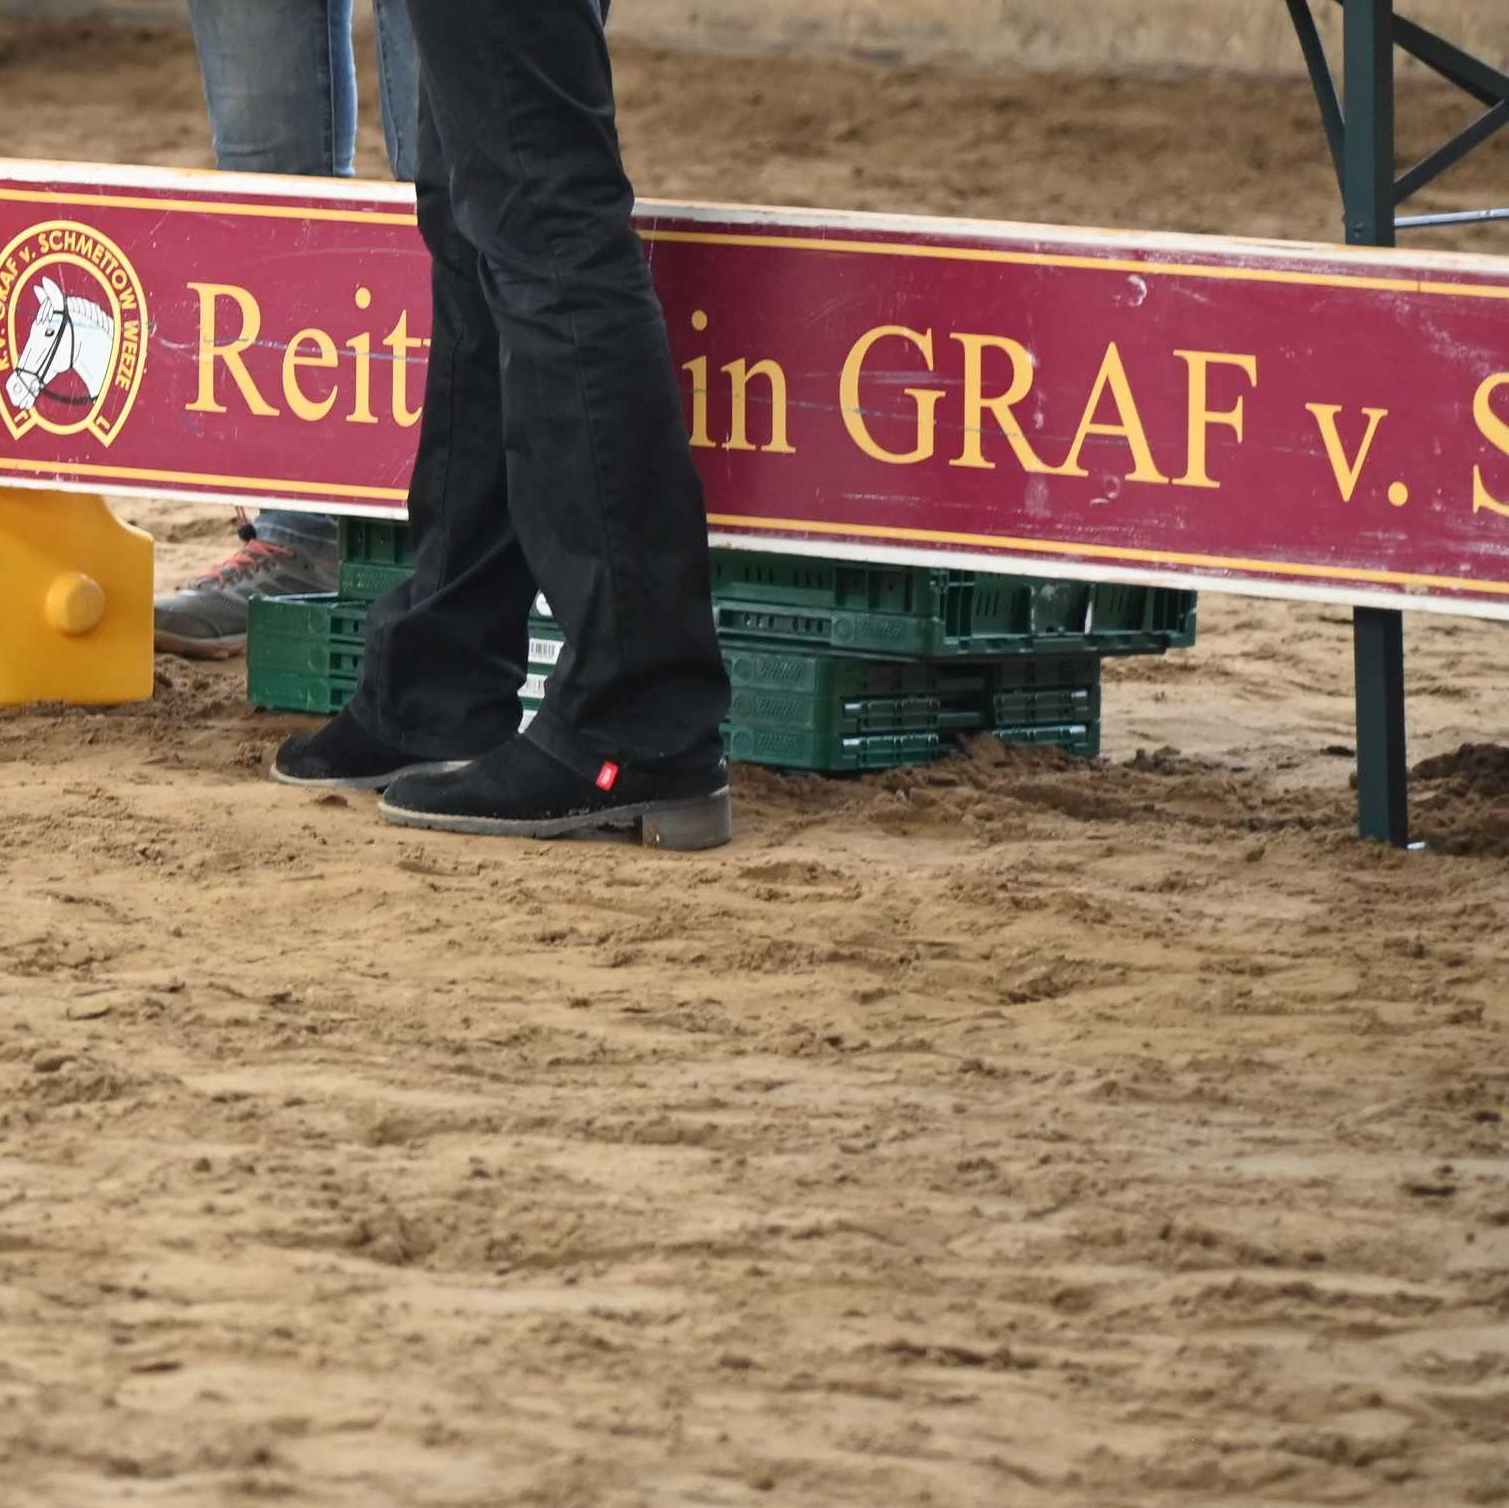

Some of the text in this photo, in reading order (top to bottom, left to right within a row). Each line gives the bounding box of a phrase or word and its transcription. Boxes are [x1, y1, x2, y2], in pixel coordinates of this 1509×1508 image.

[37, 230, 138, 310] SCHMETTOW
[114, 320, 139, 391] WEEZE
[839, 324, 1258, 488] GRAF
[1306, 401, 1409, 507] v.
